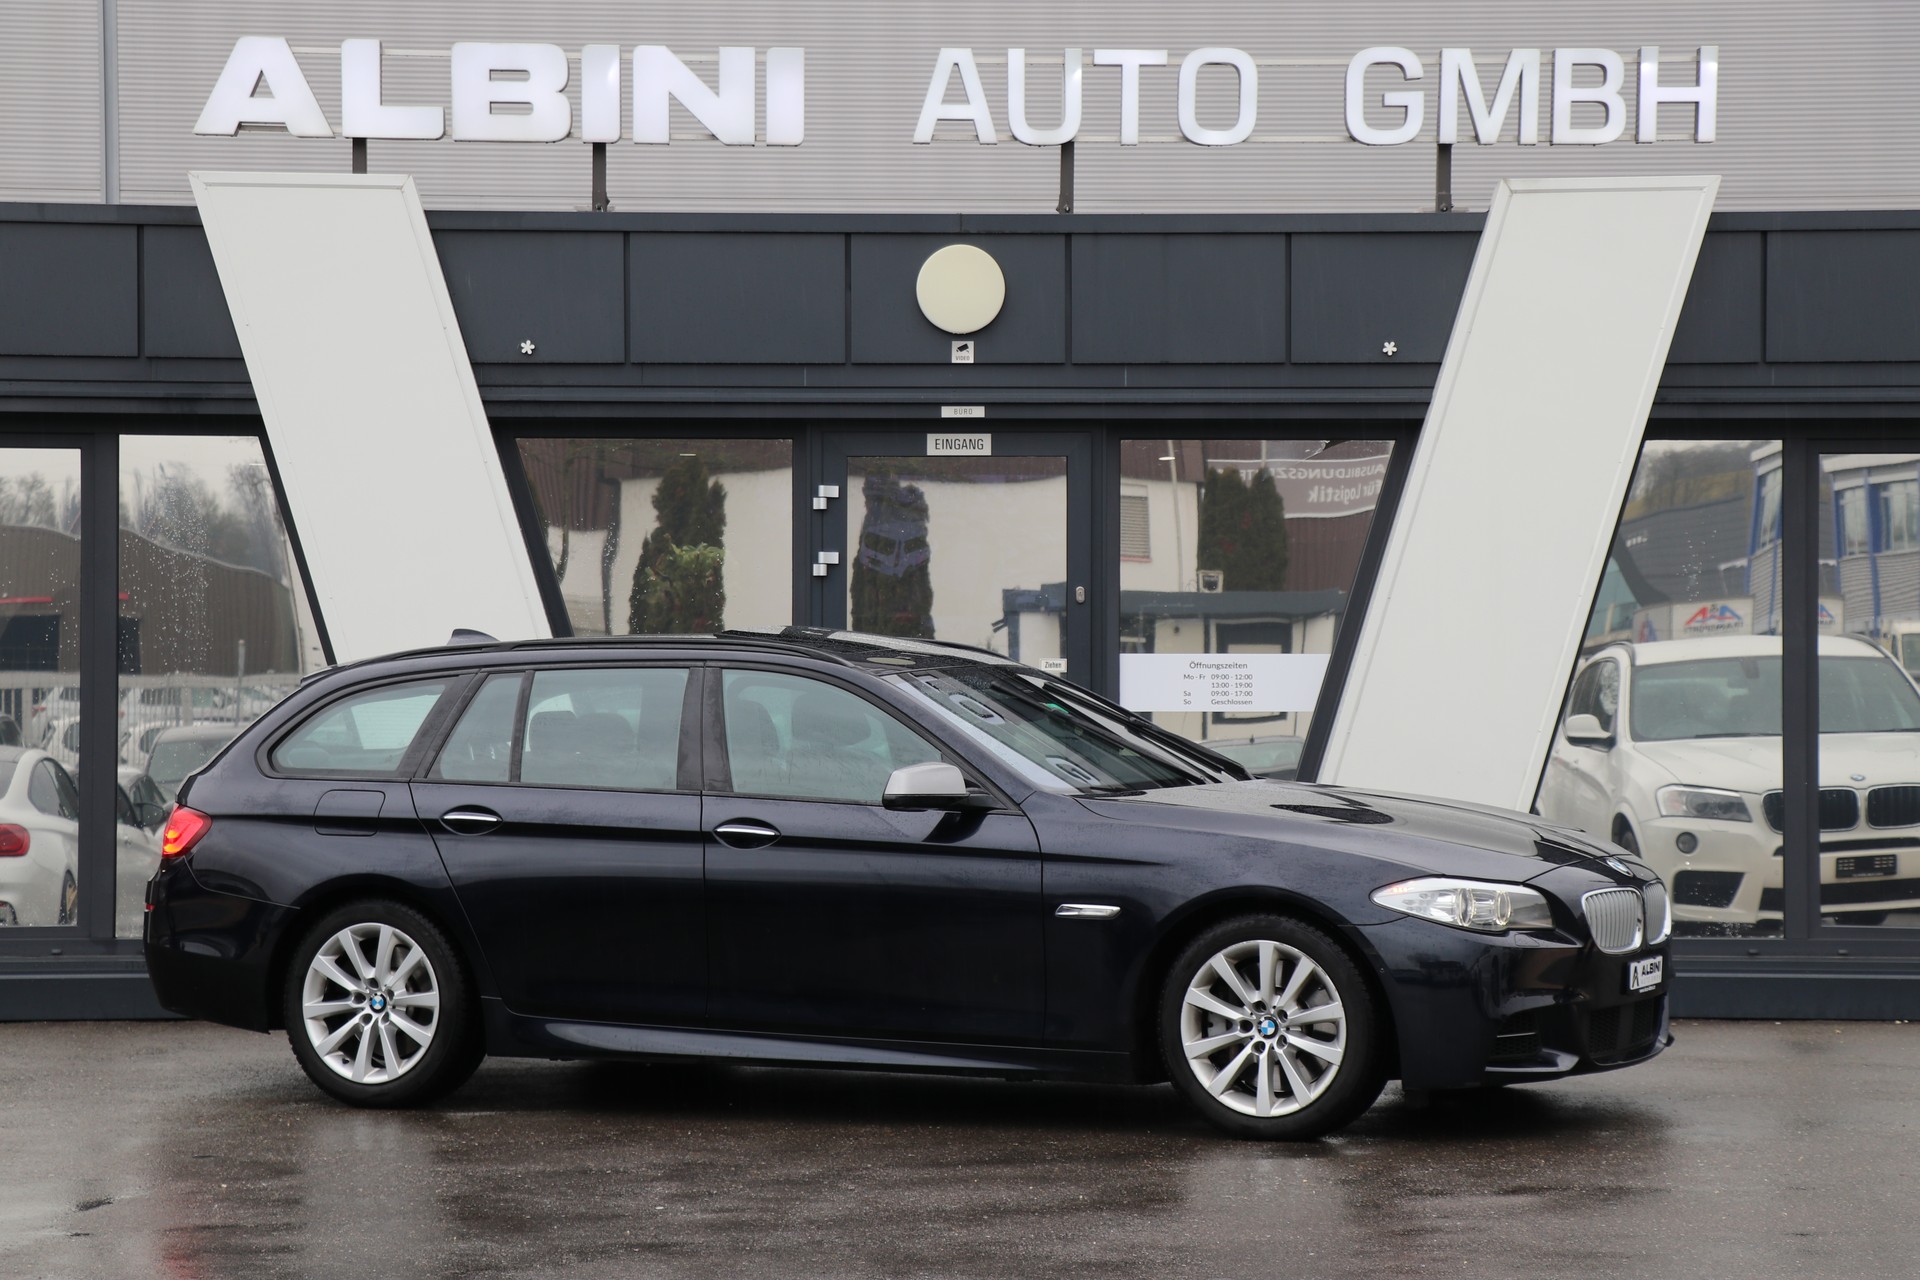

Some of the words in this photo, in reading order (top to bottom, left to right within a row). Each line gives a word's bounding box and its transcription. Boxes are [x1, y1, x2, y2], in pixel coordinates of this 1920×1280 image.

[192, 36, 805, 146] ALBINI
[913, 46, 1258, 147] AUTO
[1345, 45, 1718, 147] GMBH
[935, 438, 984, 450] EINGANG
[1189, 661, 1248, 670] Öffnungszeiten
